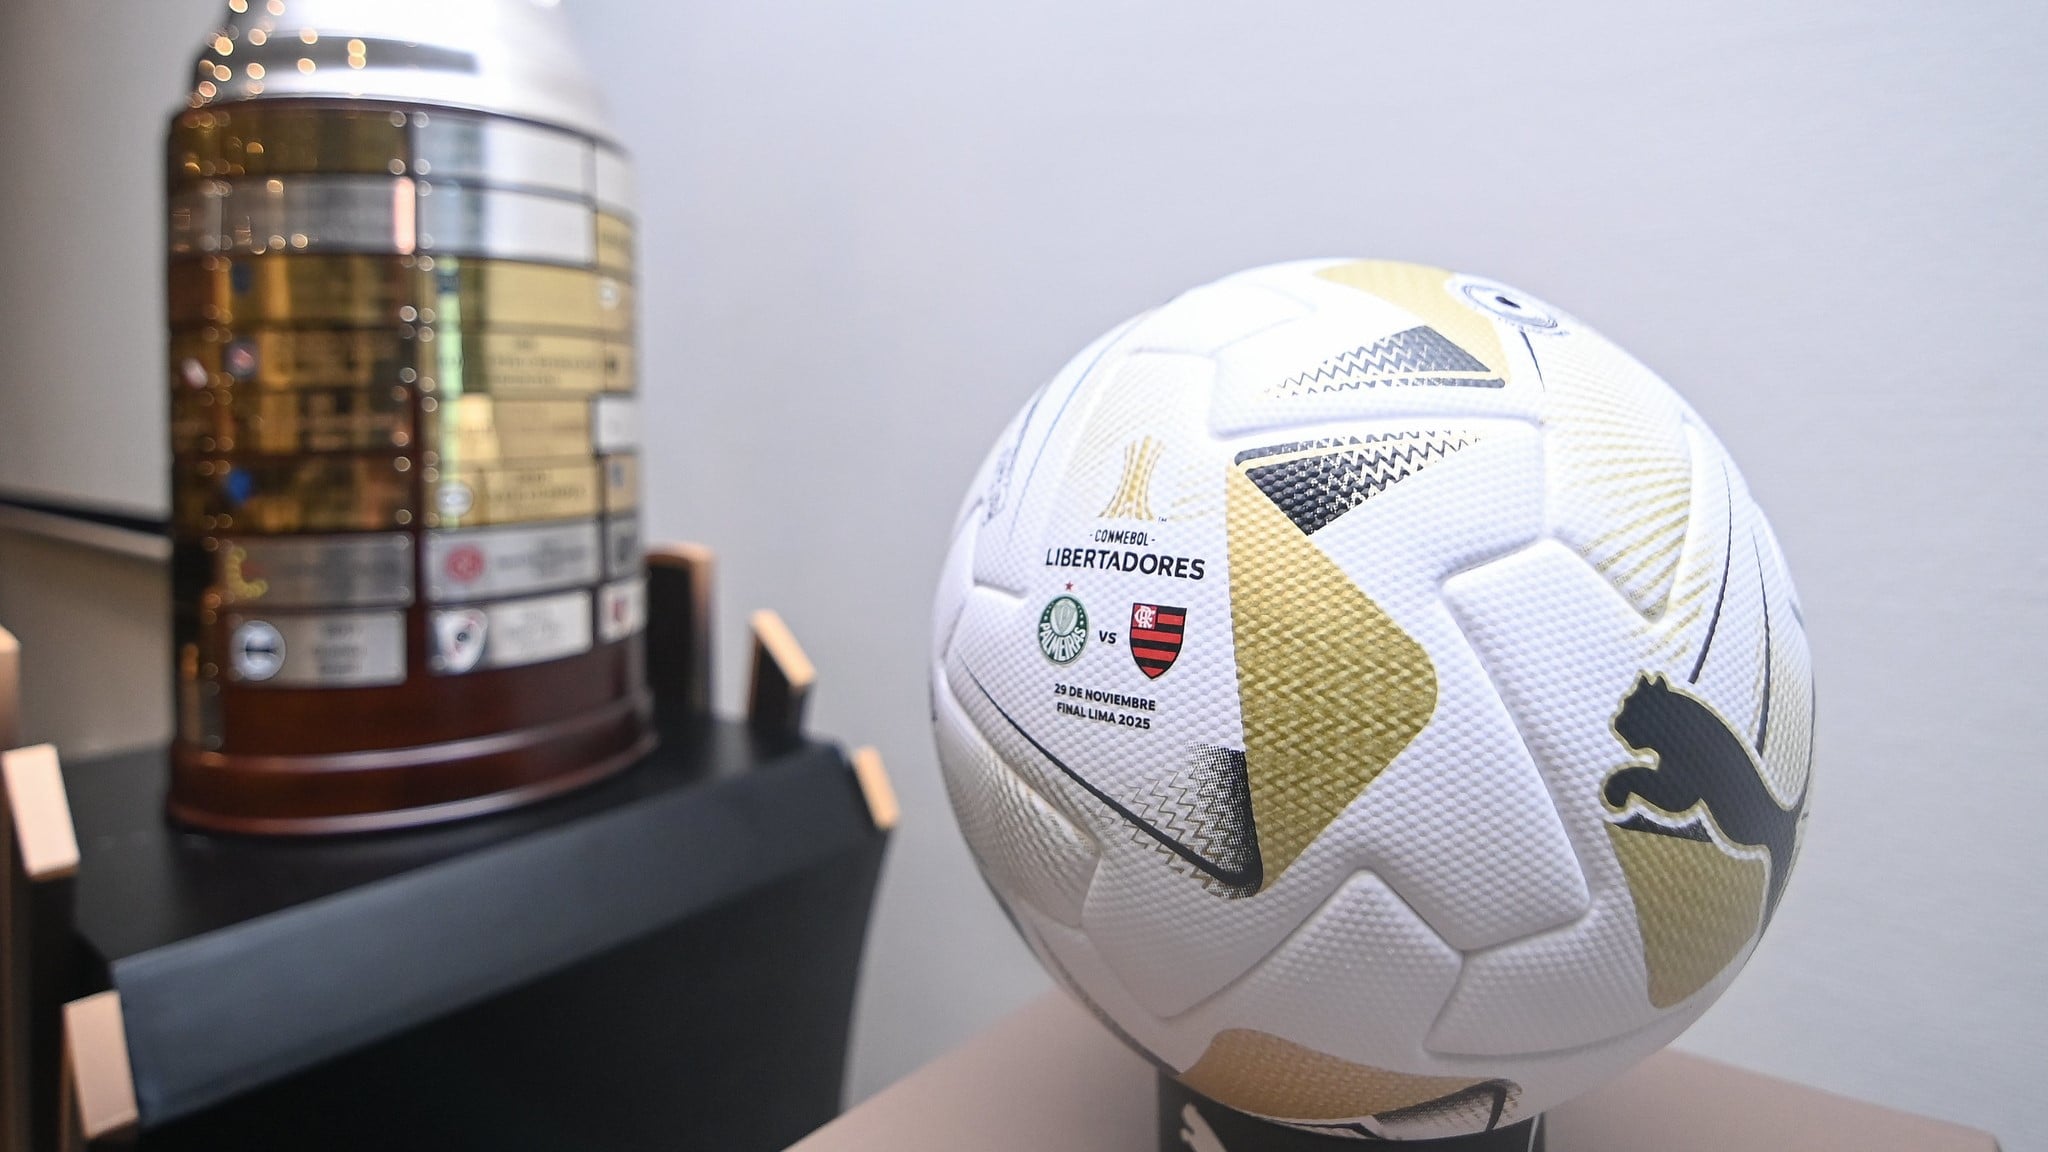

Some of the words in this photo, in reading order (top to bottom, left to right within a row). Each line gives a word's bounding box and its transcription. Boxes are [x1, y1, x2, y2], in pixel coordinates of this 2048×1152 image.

[1095, 529, 1149, 546] CONMEBOL
[1045, 547, 1205, 580] LIBERTADORES
[1040, 622, 1086, 661] PALMEIRAS
[1054, 683, 1067, 695] 29
[1069, 685, 1083, 698] DE
[1085, 688, 1156, 711] NOVIEMBRE
[1056, 701, 1086, 718] FINAL
[1088, 707, 1116, 724] LIMA
[1118, 713, 1151, 730] 2025
